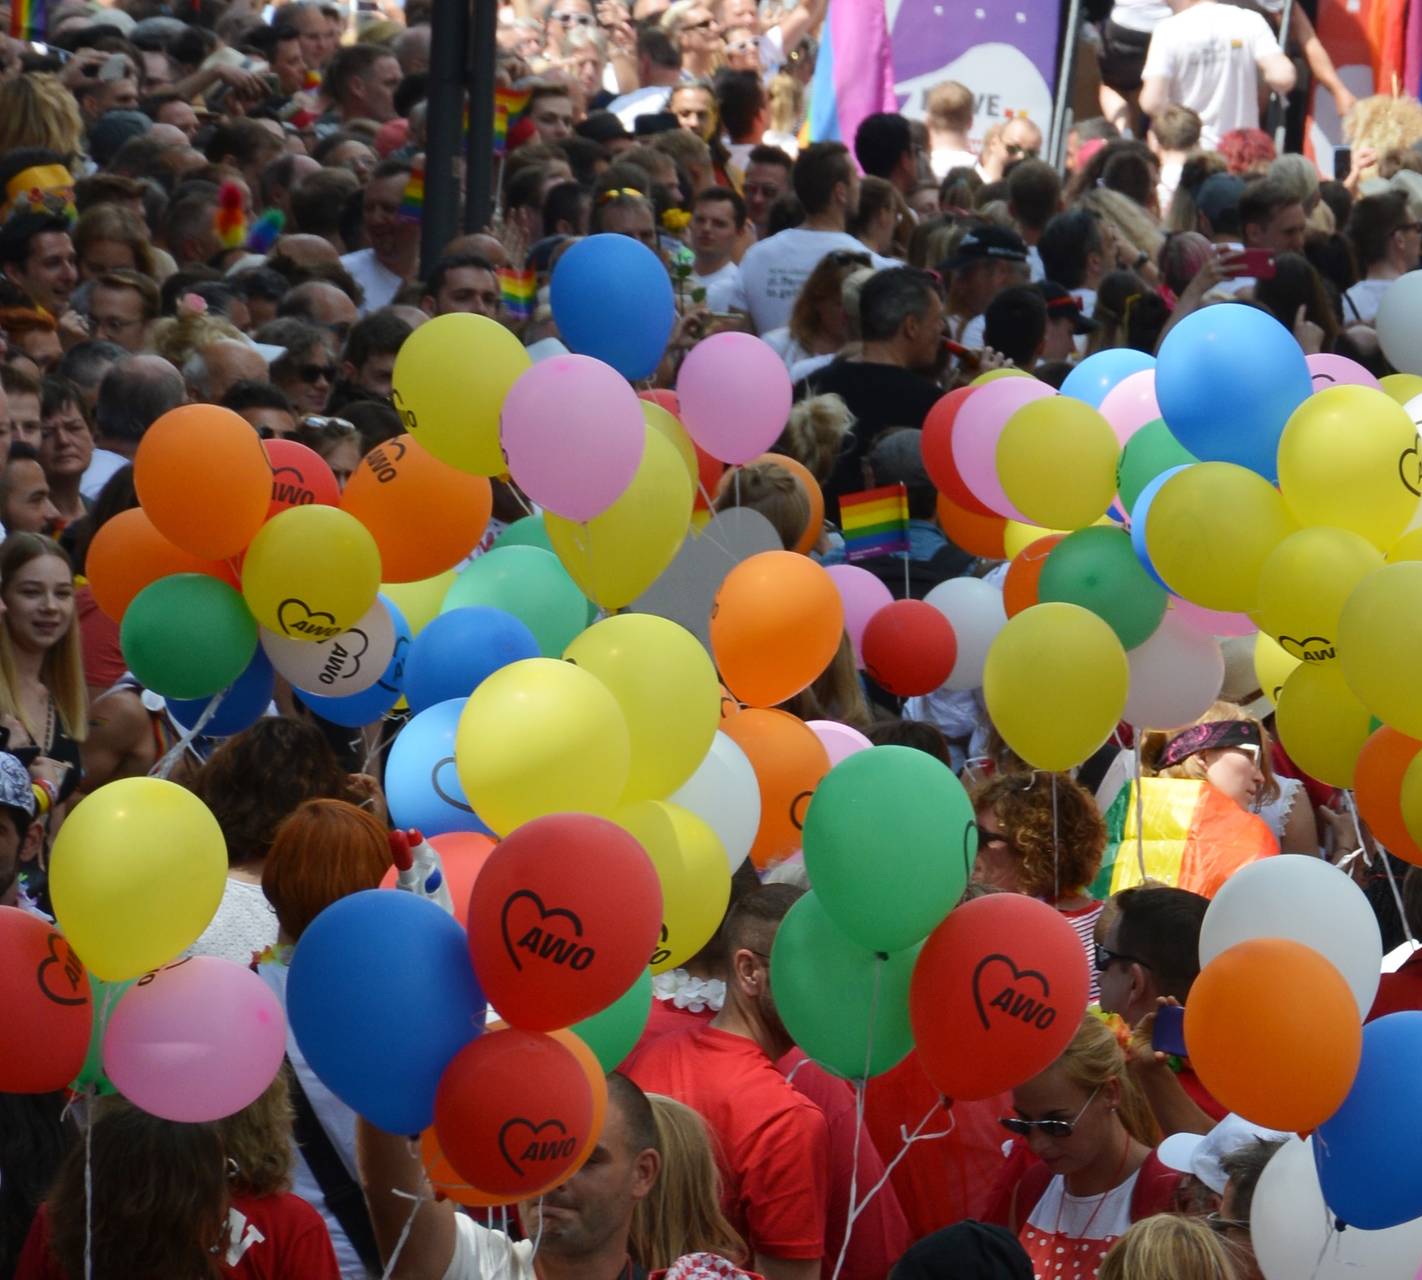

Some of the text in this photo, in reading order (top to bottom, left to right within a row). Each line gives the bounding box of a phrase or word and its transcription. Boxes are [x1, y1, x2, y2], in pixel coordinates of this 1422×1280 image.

[318, 642, 349, 685] AWO
[1303, 647, 1337, 661] AW
[517, 926, 596, 971] AWO
[988, 987, 1057, 1030] AWO
[520, 1136, 576, 1161] AWO
